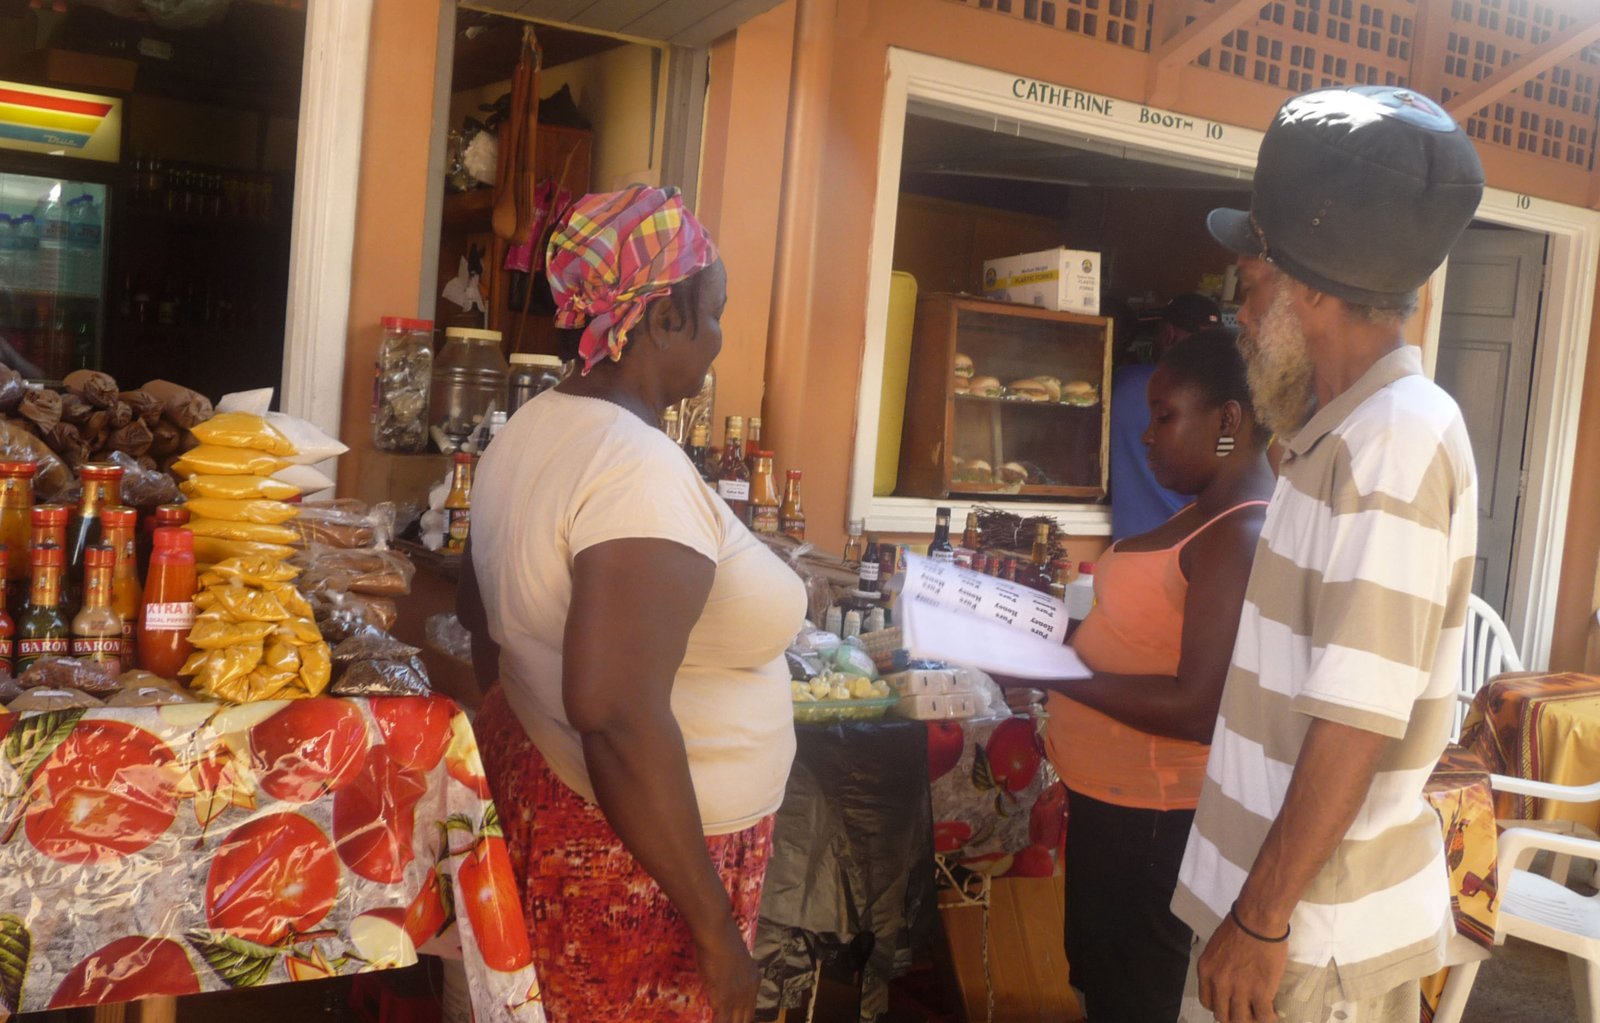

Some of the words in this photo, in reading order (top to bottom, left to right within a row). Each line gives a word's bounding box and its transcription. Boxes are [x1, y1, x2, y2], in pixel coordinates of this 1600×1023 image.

[1012, 78, 1114, 117] CATHERINE
[1139, 107, 1194, 131] BOOTH
[1205, 122, 1224, 140] 10
[1516, 193, 1531, 210] 10
[1030, 616, 1054, 633] Honey
[1030, 627, 1049, 640] Pure
[21, 640, 69, 653] BARON
[74, 640, 121, 653] BARON
